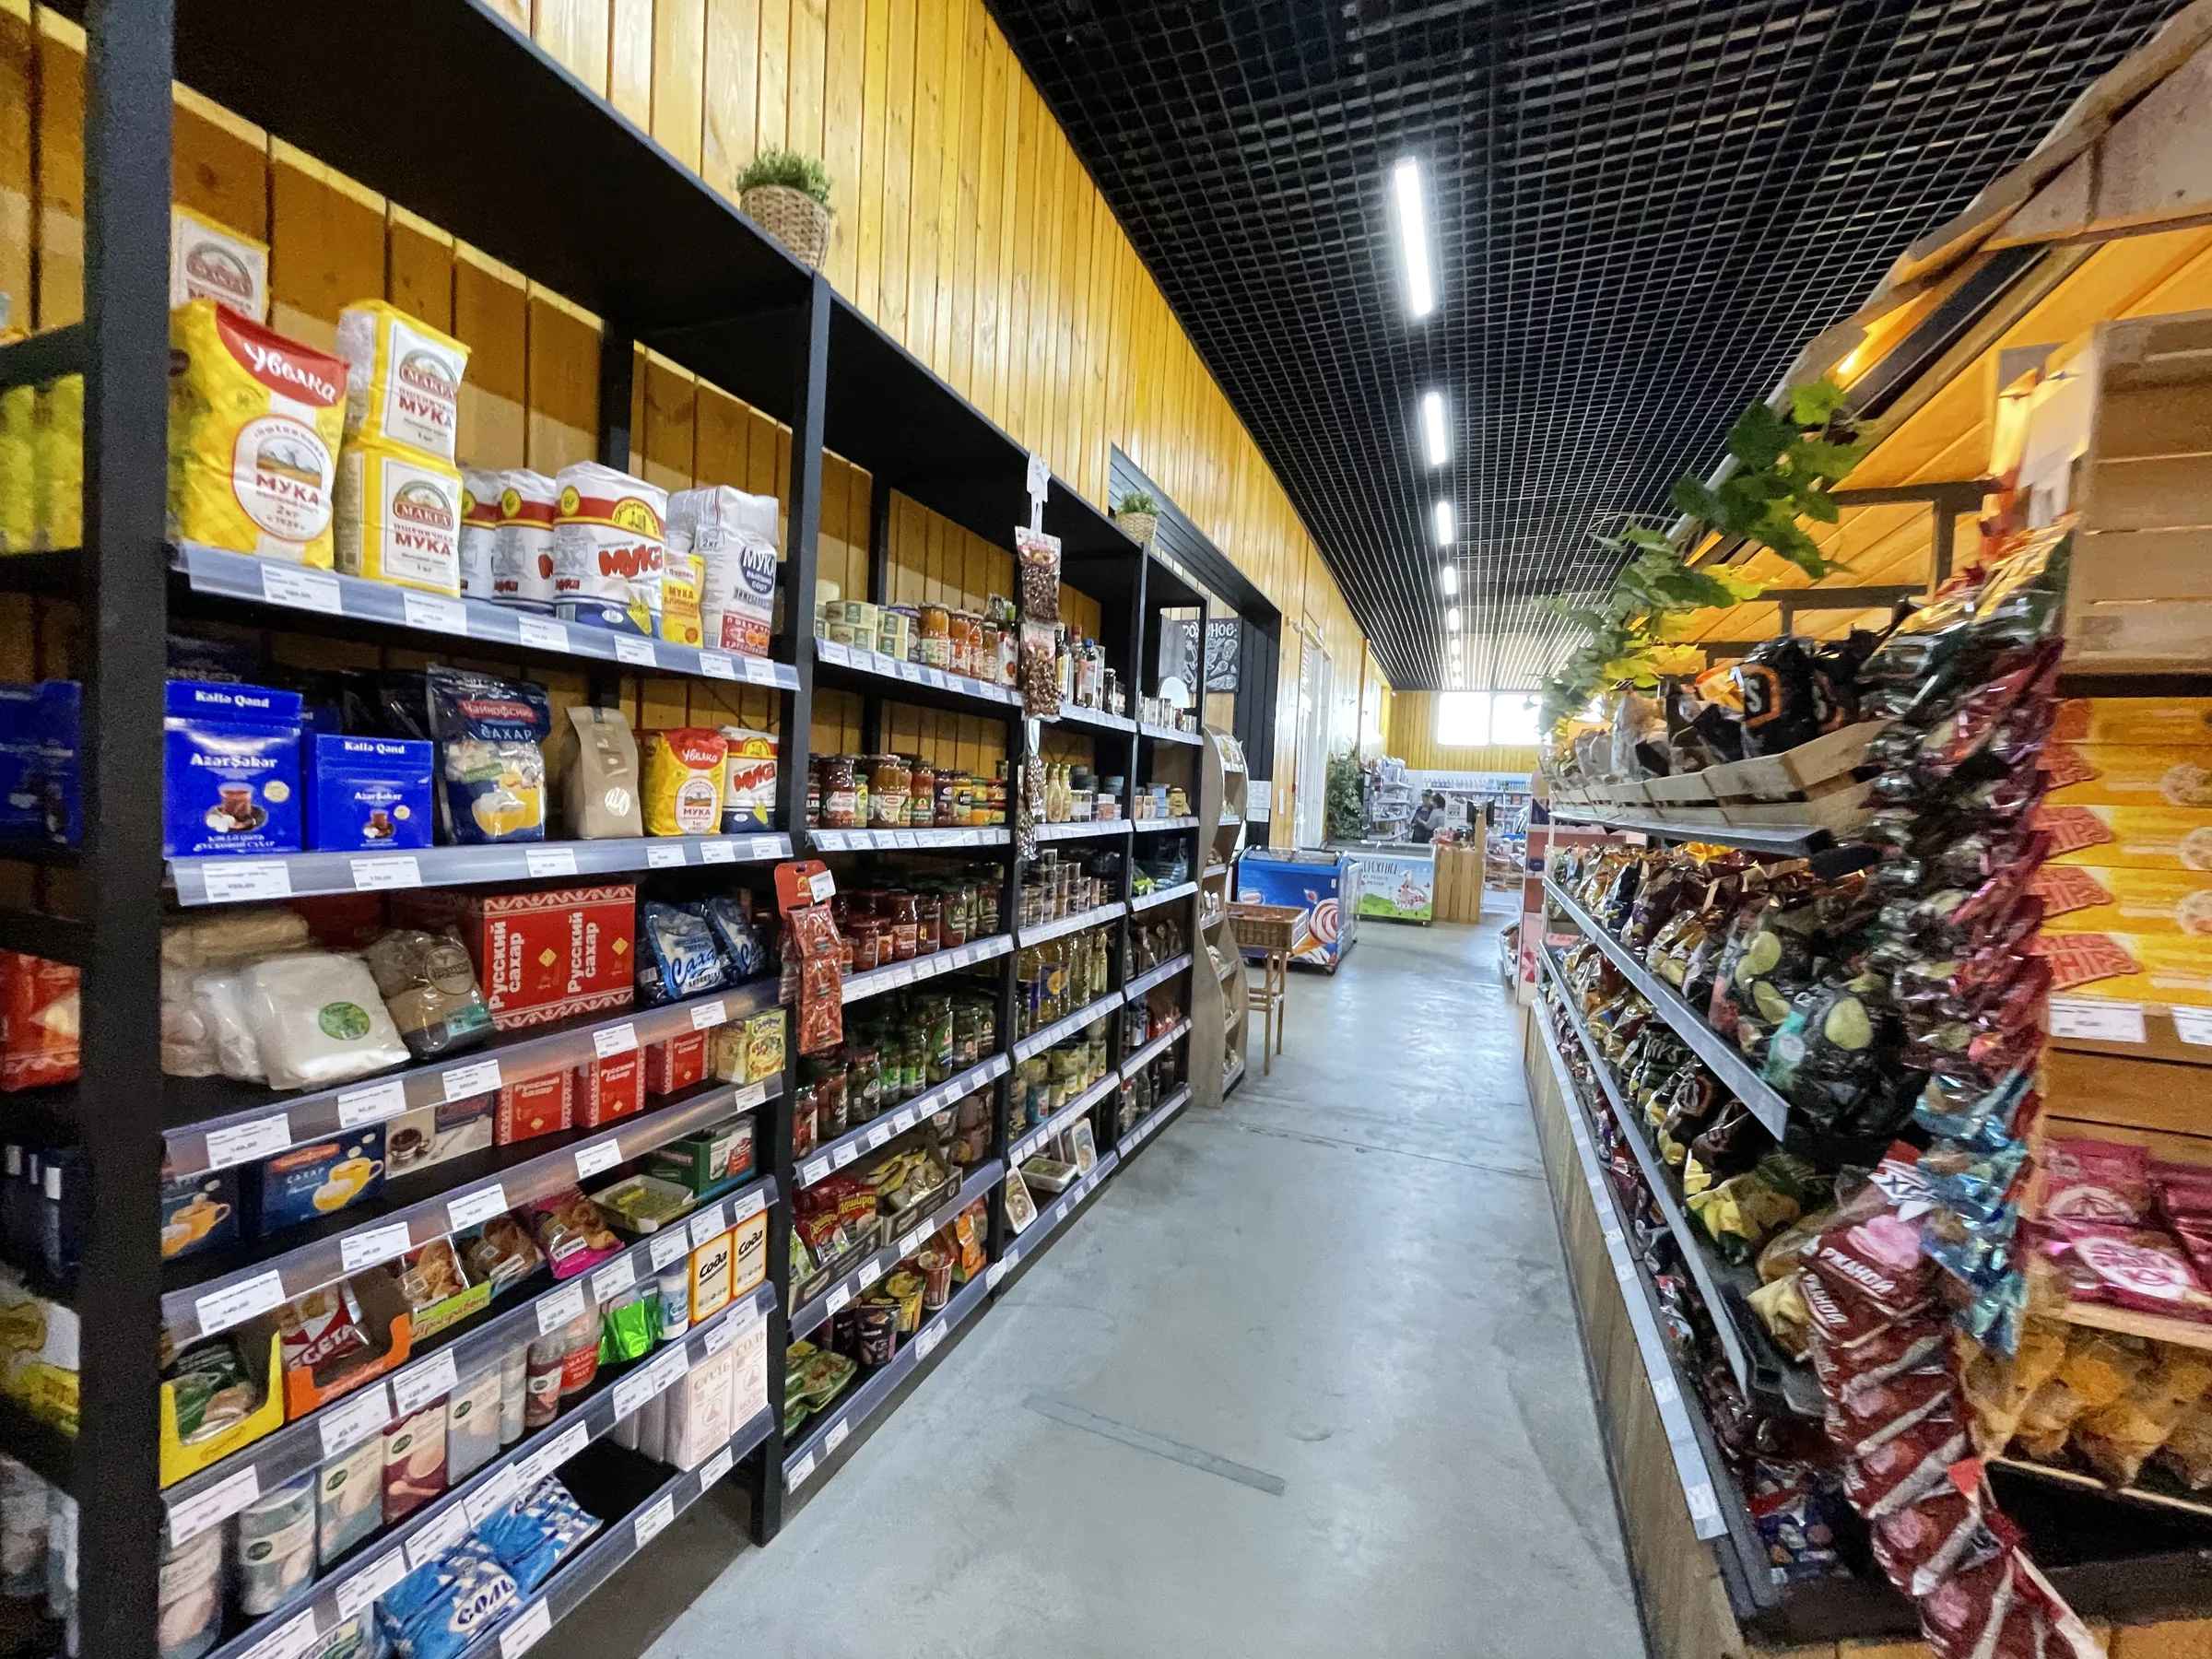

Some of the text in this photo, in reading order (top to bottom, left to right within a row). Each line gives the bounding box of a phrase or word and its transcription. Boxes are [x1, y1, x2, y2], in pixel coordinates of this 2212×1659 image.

[398, 395, 453, 430] МУКА
[256, 474, 320, 507] МУКА
[394, 532, 452, 557] МУКА
[734, 547, 775, 576] МУКА
[668, 585, 694, 600] МУКА
[681, 748, 718, 763] Увелка
[683, 807, 712, 816] МУКА
[488, 921, 508, 1010] Русский
[509, 933, 525, 993] сахар
[567, 912, 584, 994] Русский
[584, 922, 600, 978] сахар
[838, 1194, 877, 1215] Дошира
[738, 1230, 763, 1256] Сода
[699, 1250, 728, 1278] Сода
[1803, 1274, 1849, 1324] РЖАНОЙ
[456, 1578, 514, 1626] СОЛЬ
